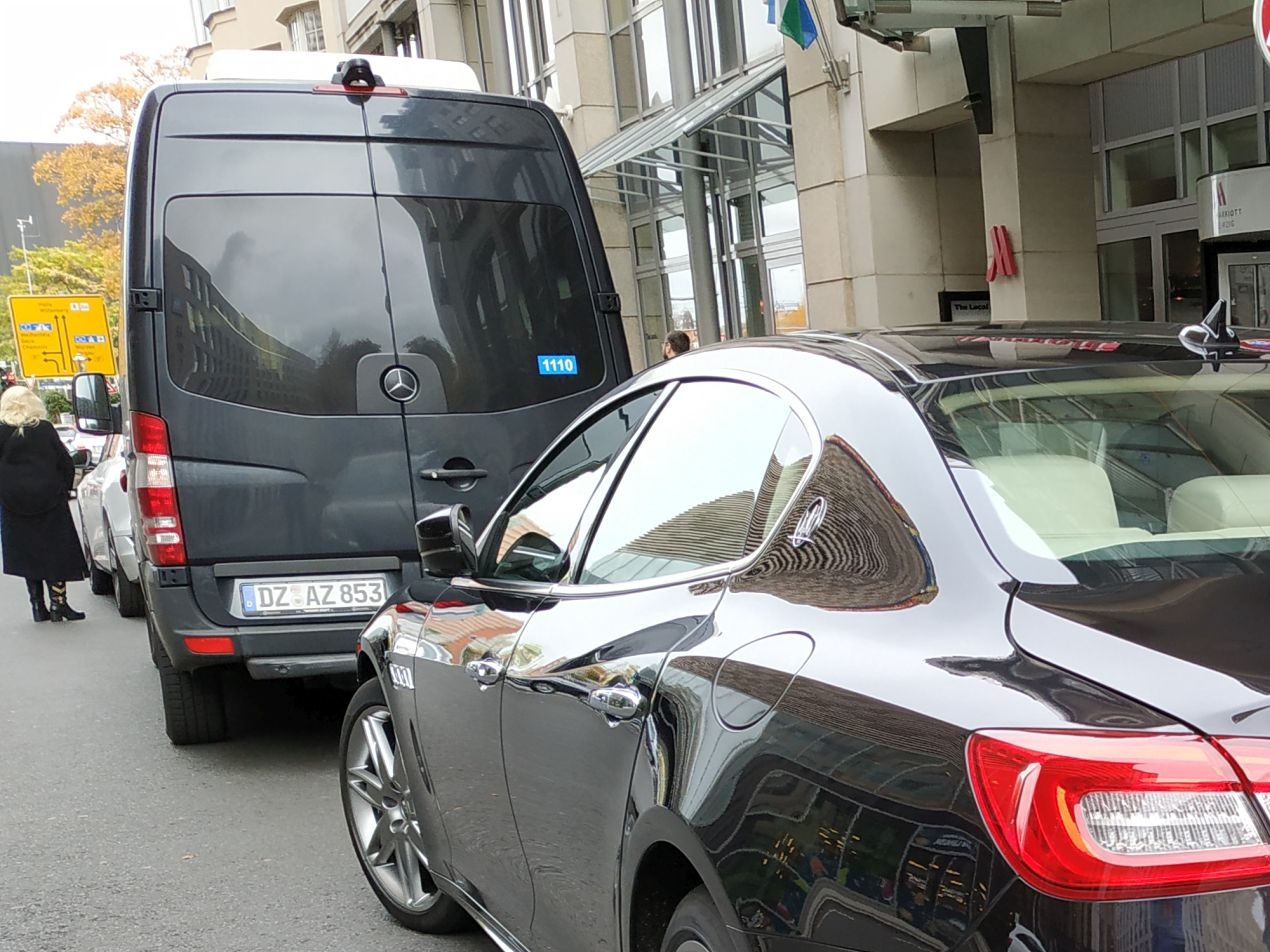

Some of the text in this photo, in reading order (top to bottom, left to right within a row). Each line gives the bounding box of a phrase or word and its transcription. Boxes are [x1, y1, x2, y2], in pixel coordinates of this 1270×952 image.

[542, 359, 573, 372] 1110
[257, 586, 290, 608] DZ
[306, 584, 337, 606] AZ
[340, 582, 383, 604] 853
